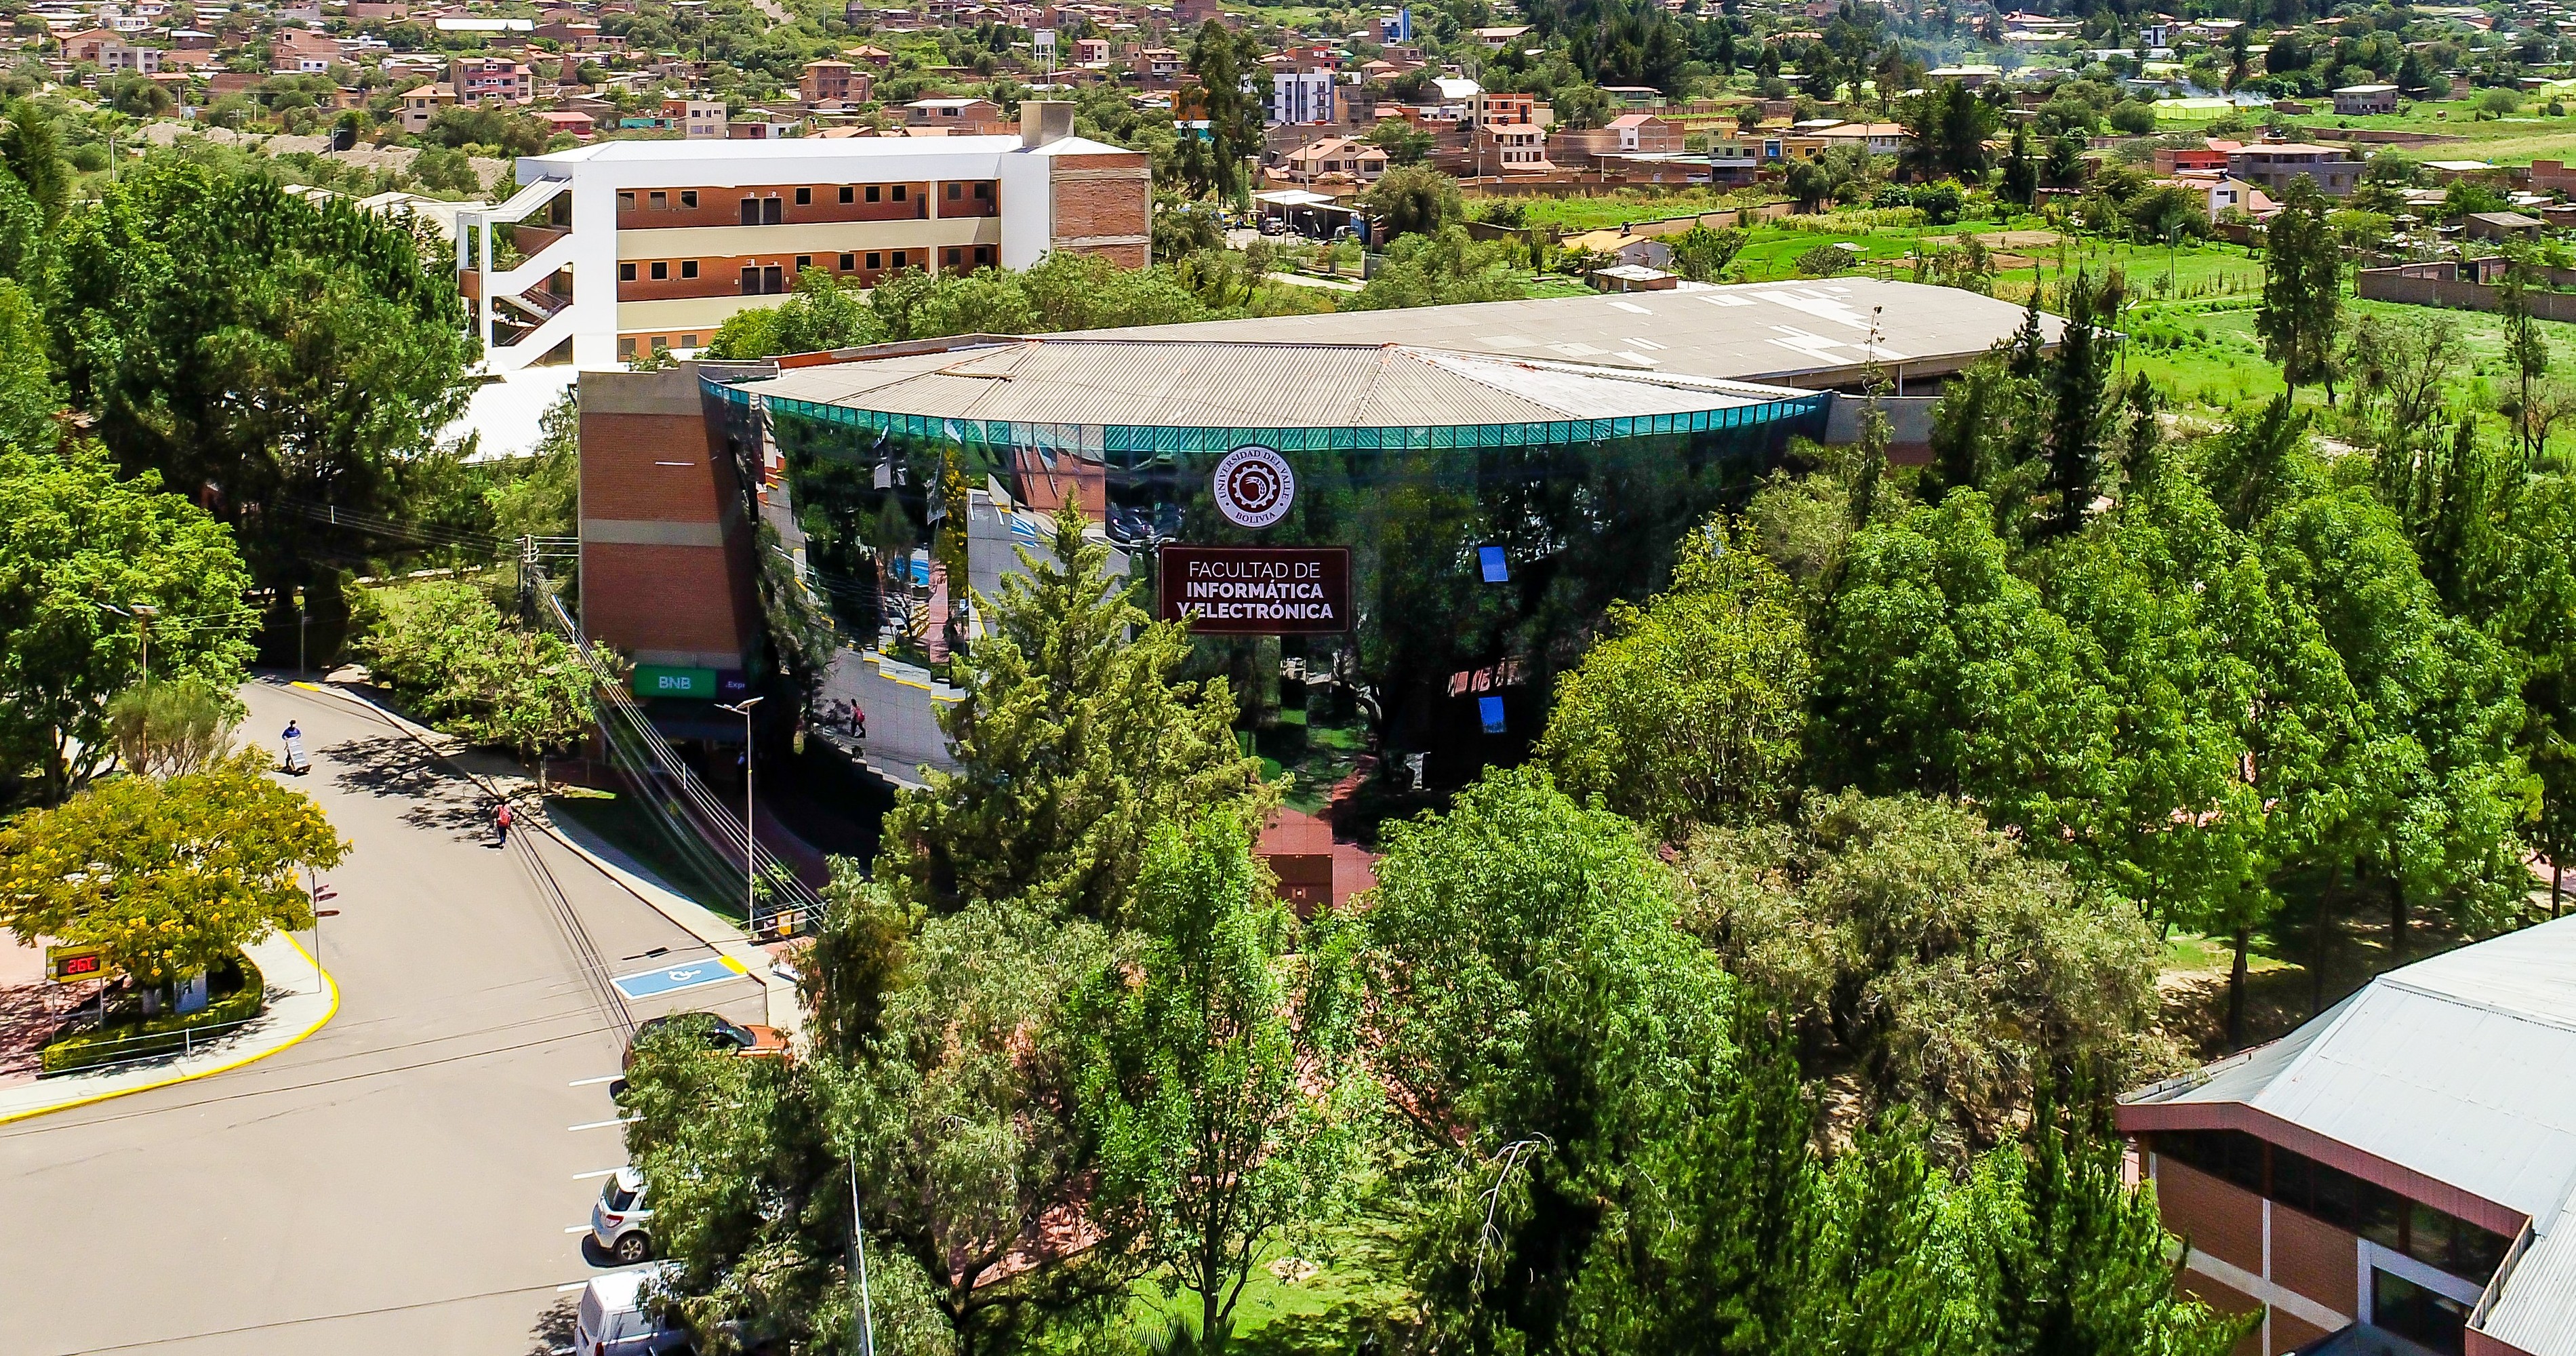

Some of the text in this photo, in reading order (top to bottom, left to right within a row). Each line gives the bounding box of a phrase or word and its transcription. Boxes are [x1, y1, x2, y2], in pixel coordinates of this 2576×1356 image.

[1218, 450, 1291, 500] UNIVERSIDAD DEL VALLE
[1235, 512, 1276, 523] BOLIVIA
[1189, 561, 1321, 578] FACULTAD DE
[1186, 580, 1324, 599] INFORMÁTICA
[1176, 600, 1333, 620] Y ELECTRÓNICA
[659, 676, 691, 690] BNB
